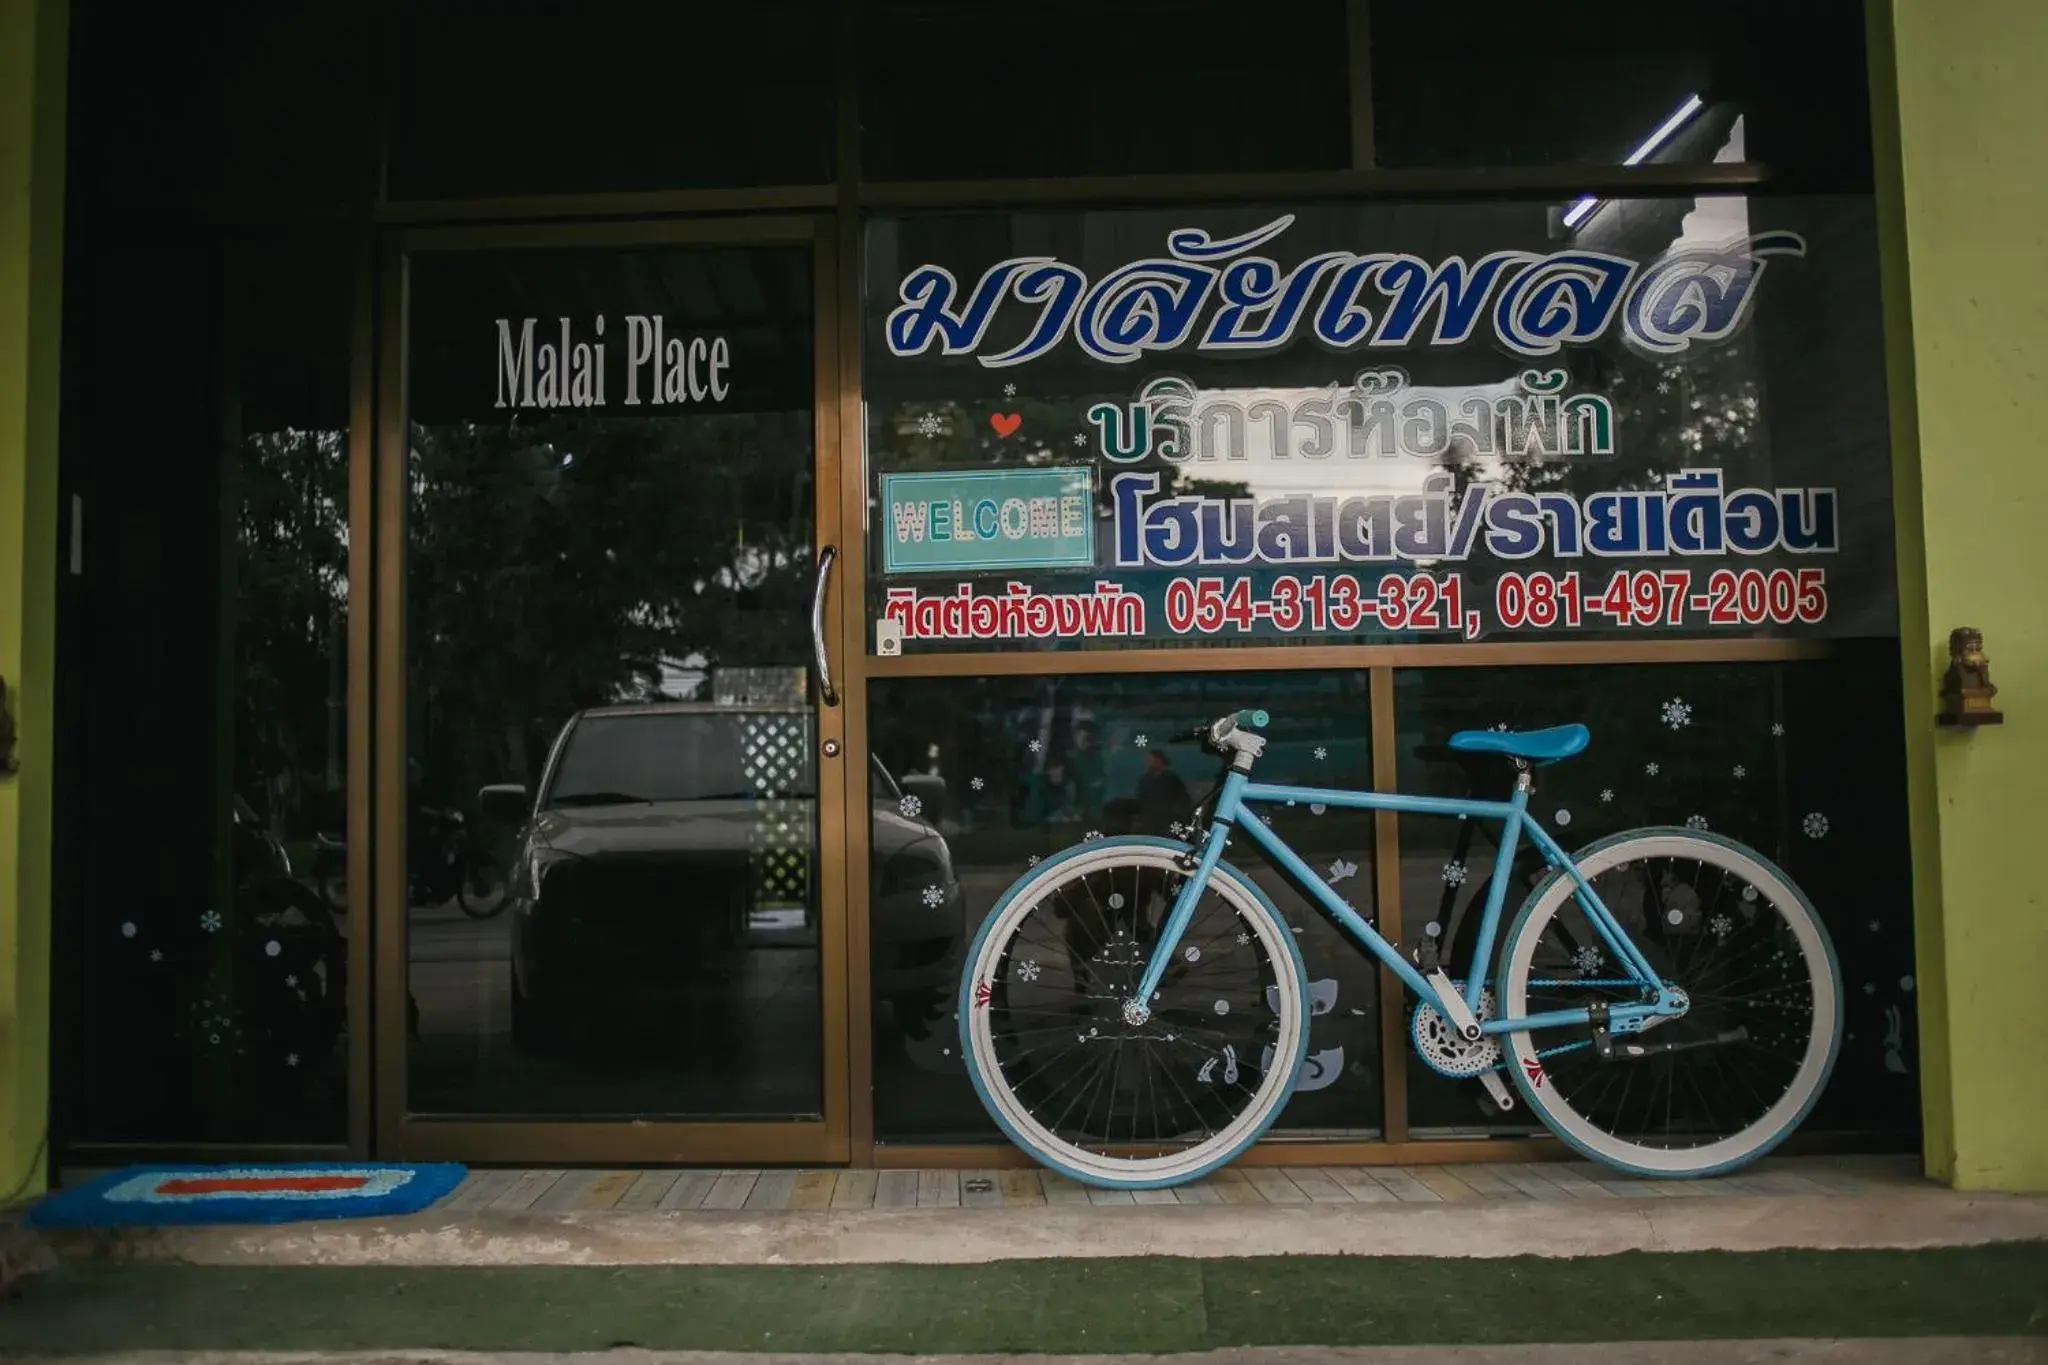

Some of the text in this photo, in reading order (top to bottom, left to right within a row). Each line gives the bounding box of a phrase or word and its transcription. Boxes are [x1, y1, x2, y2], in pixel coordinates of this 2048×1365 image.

[494, 314, 730, 408] Malai Place
[1086, 368, 1615, 464] บริการห้องพัก
[891, 496, 1086, 544] WELCOME
[1110, 468, 1840, 566] โฮมสเตย์/รายเดือน
[1164, 571, 1481, 641] 054-313-321,
[1496, 567, 1828, 629] 081-497-2005
